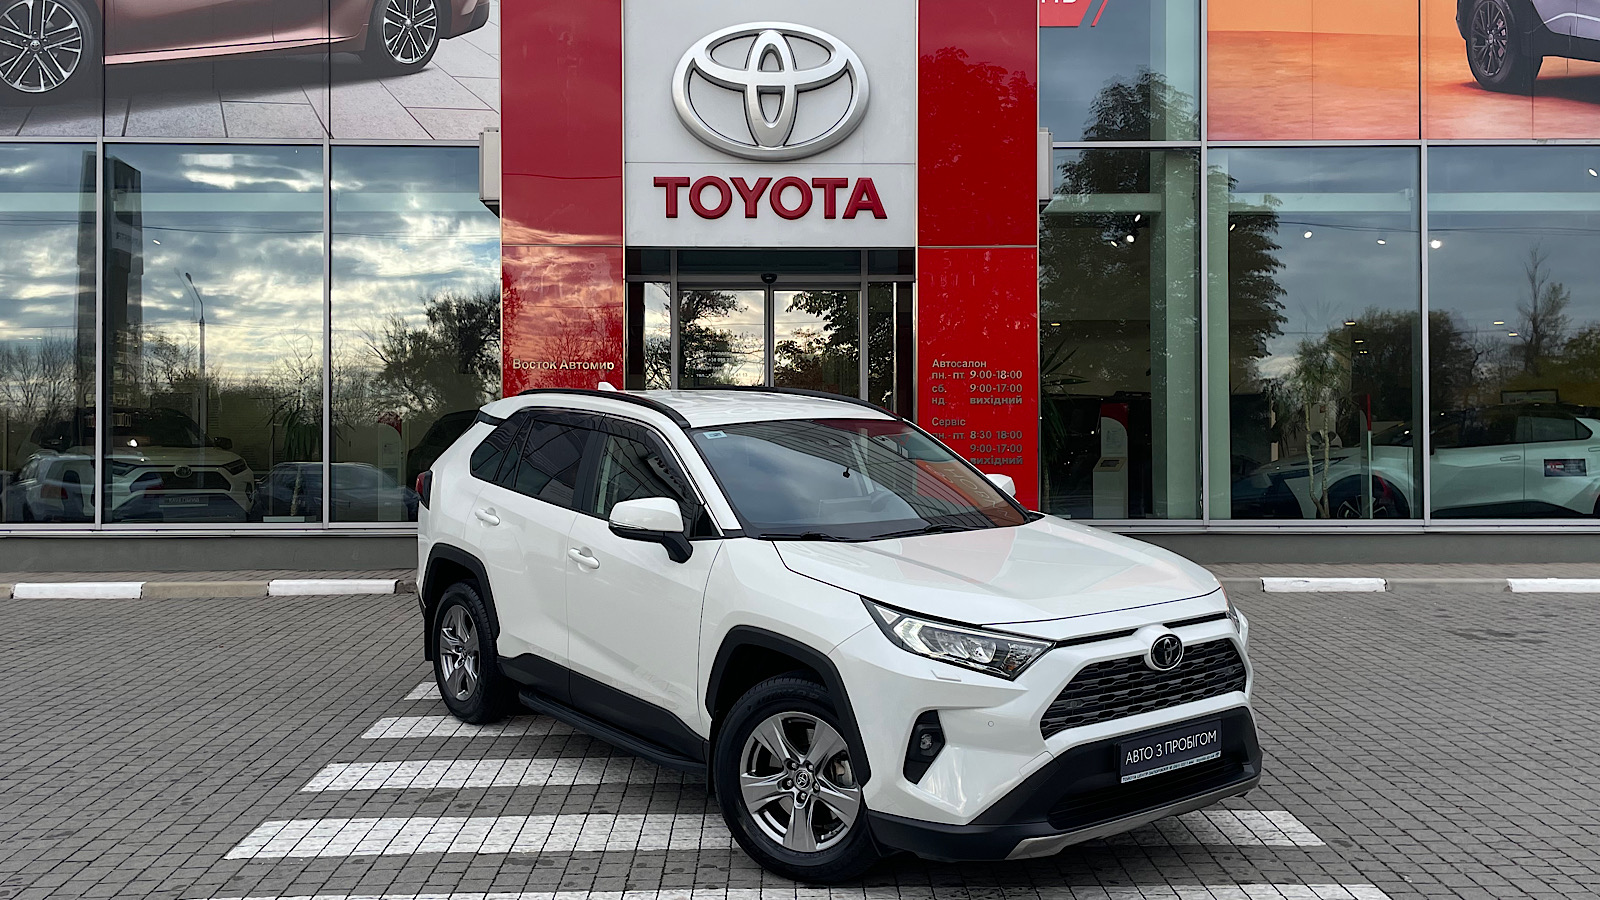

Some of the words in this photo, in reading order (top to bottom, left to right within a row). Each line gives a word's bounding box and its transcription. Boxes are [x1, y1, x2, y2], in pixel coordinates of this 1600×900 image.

[653, 176, 888, 220] TOYOTA
[512, 358, 557, 370] Восток
[560, 359, 615, 372] Автомир
[932, 359, 987, 368] Автосалон
[969, 383, 1023, 393] 9:00-17:00
[969, 395, 1023, 406] вихідний
[931, 417, 966, 428] Сервіс
[969, 443, 1023, 453] 9:00-17:00
[970, 455, 1023, 466] вихідний
[1125, 746, 1153, 765] АВТО
[1165, 729, 1217, 755] ПРОБІГОМ
